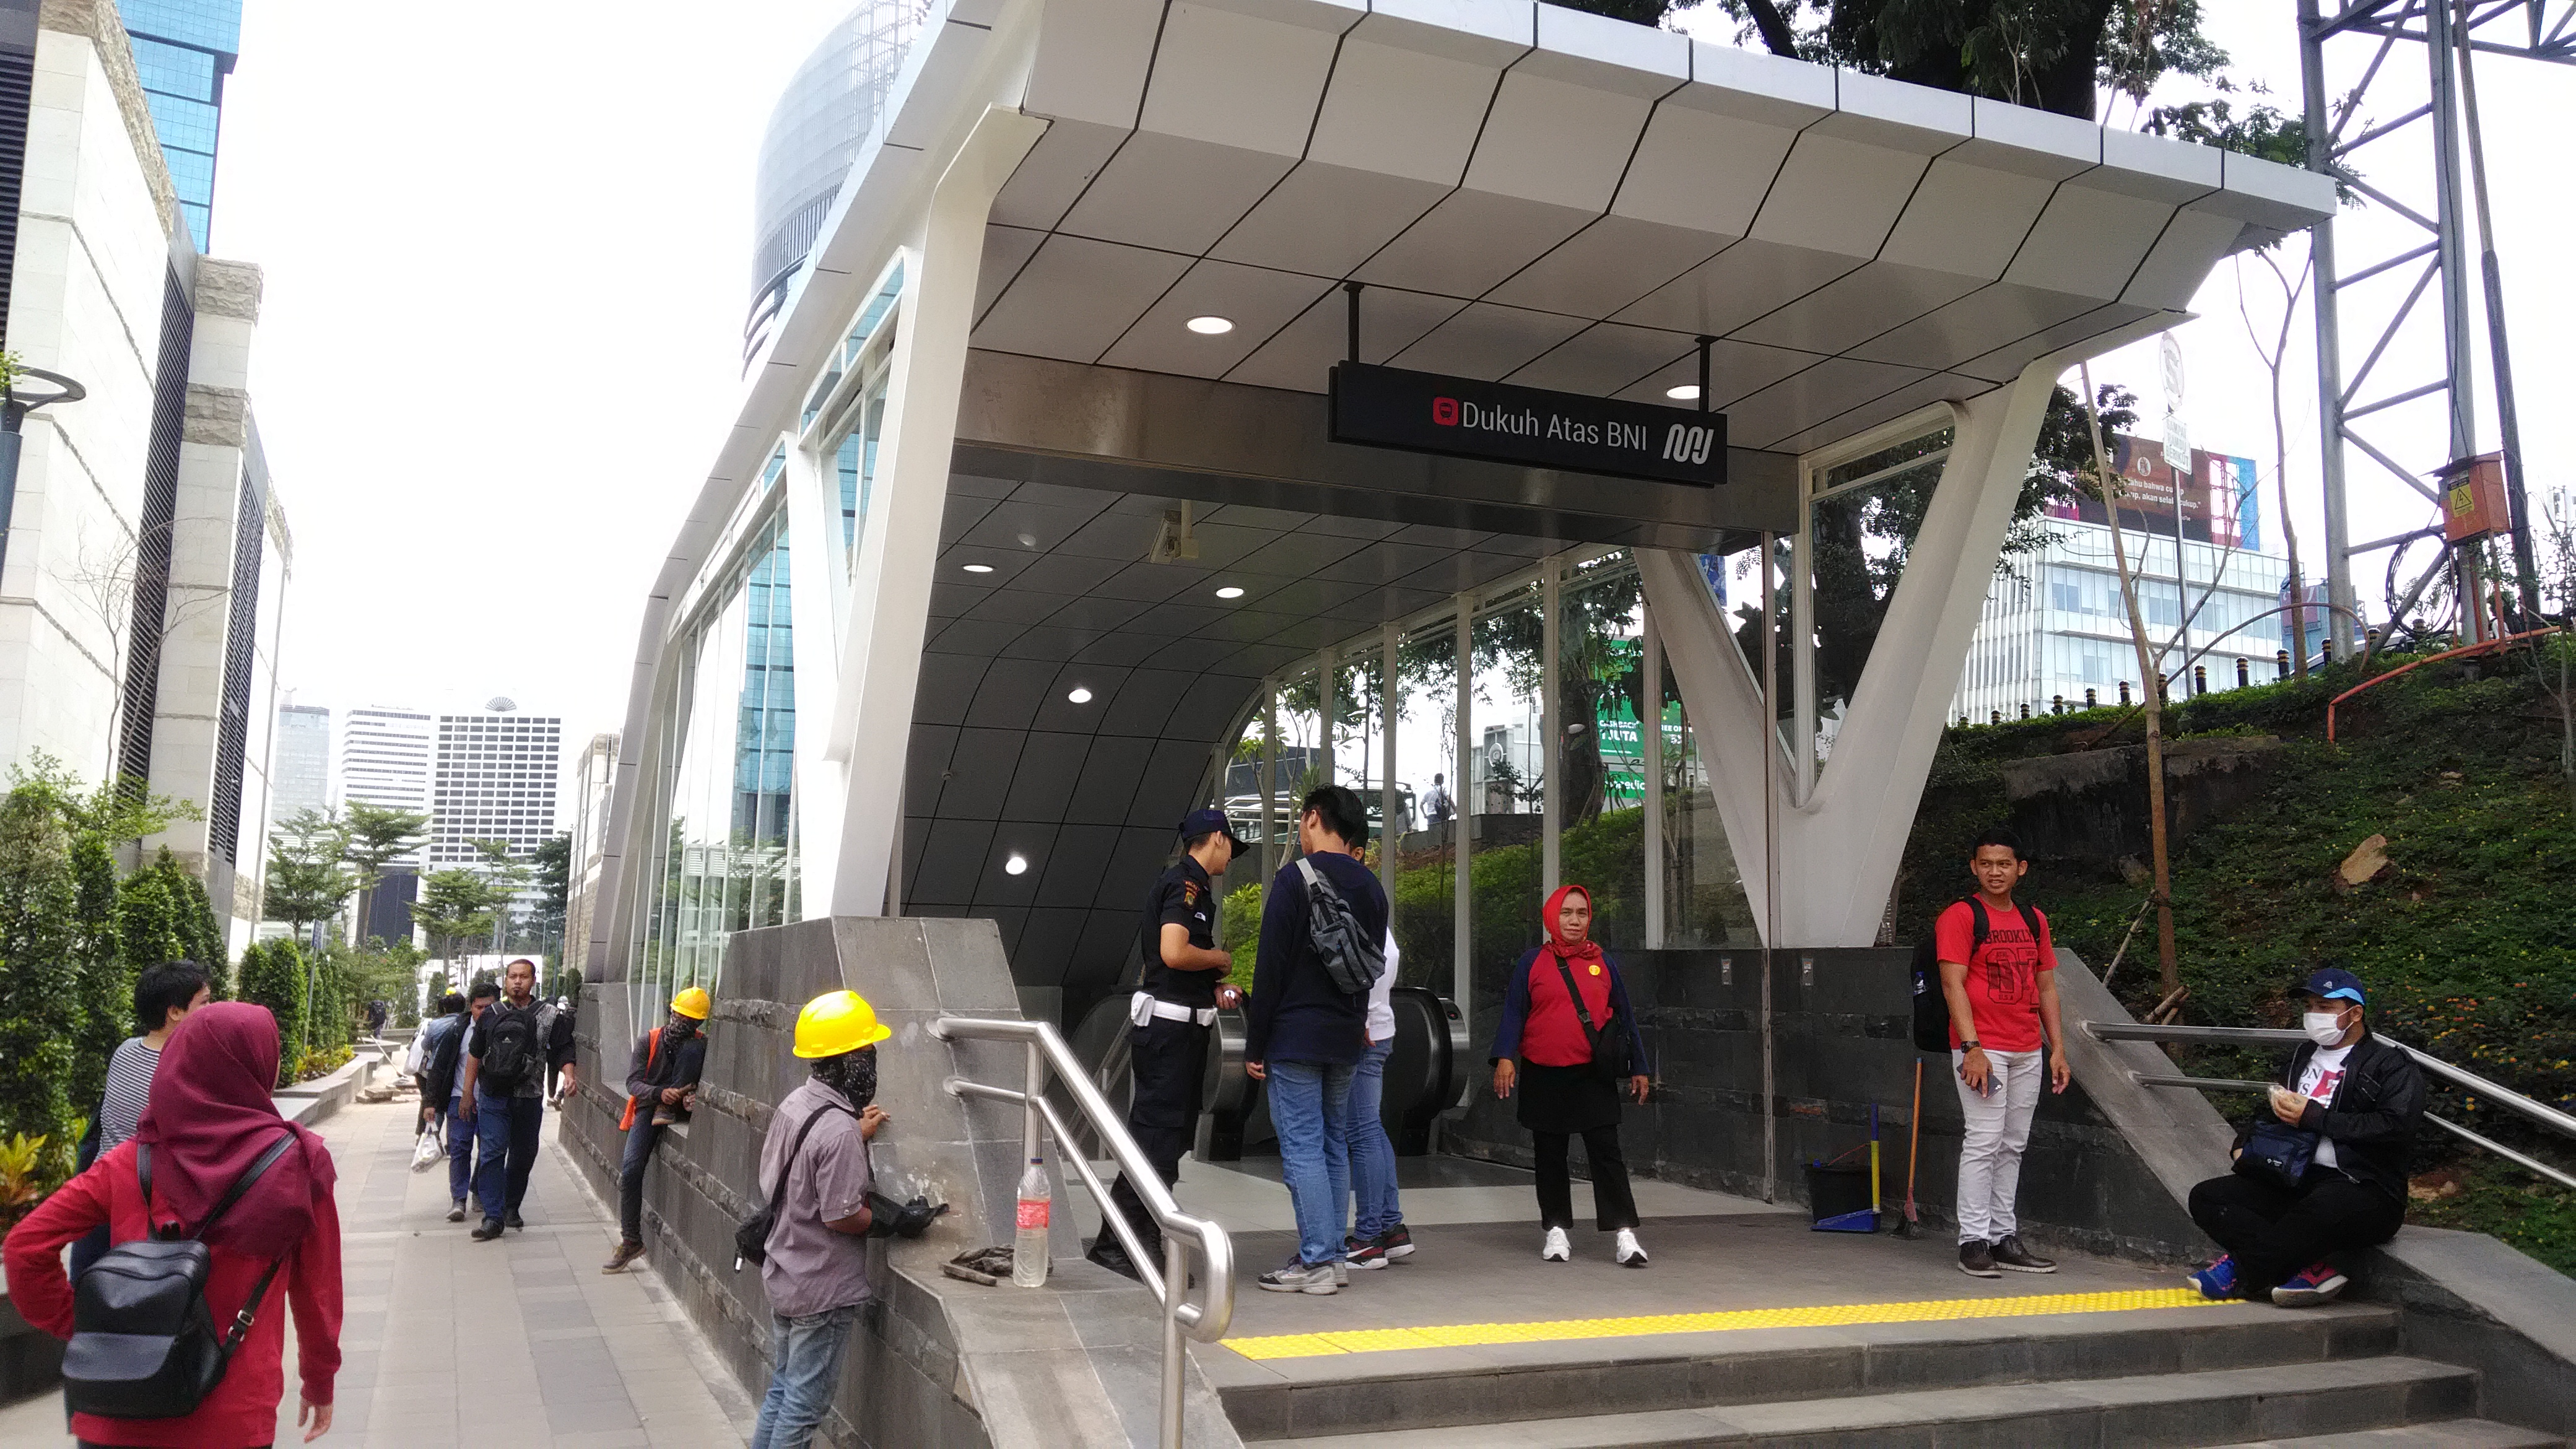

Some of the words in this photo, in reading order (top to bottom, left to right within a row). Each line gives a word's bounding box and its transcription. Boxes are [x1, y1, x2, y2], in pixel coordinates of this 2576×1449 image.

[1463, 401, 1539, 437] Dukuh
[1546, 414, 1599, 445] Atas
[1608, 420, 1647, 451] BNI
[2165, 445, 2190, 468] BERIKUT
[2144, 481, 2164, 492] bahwa
[2142, 492, 2158, 502] akan
[2159, 496, 2174, 505] selal
[1608, 729, 1638, 742] JUTA
